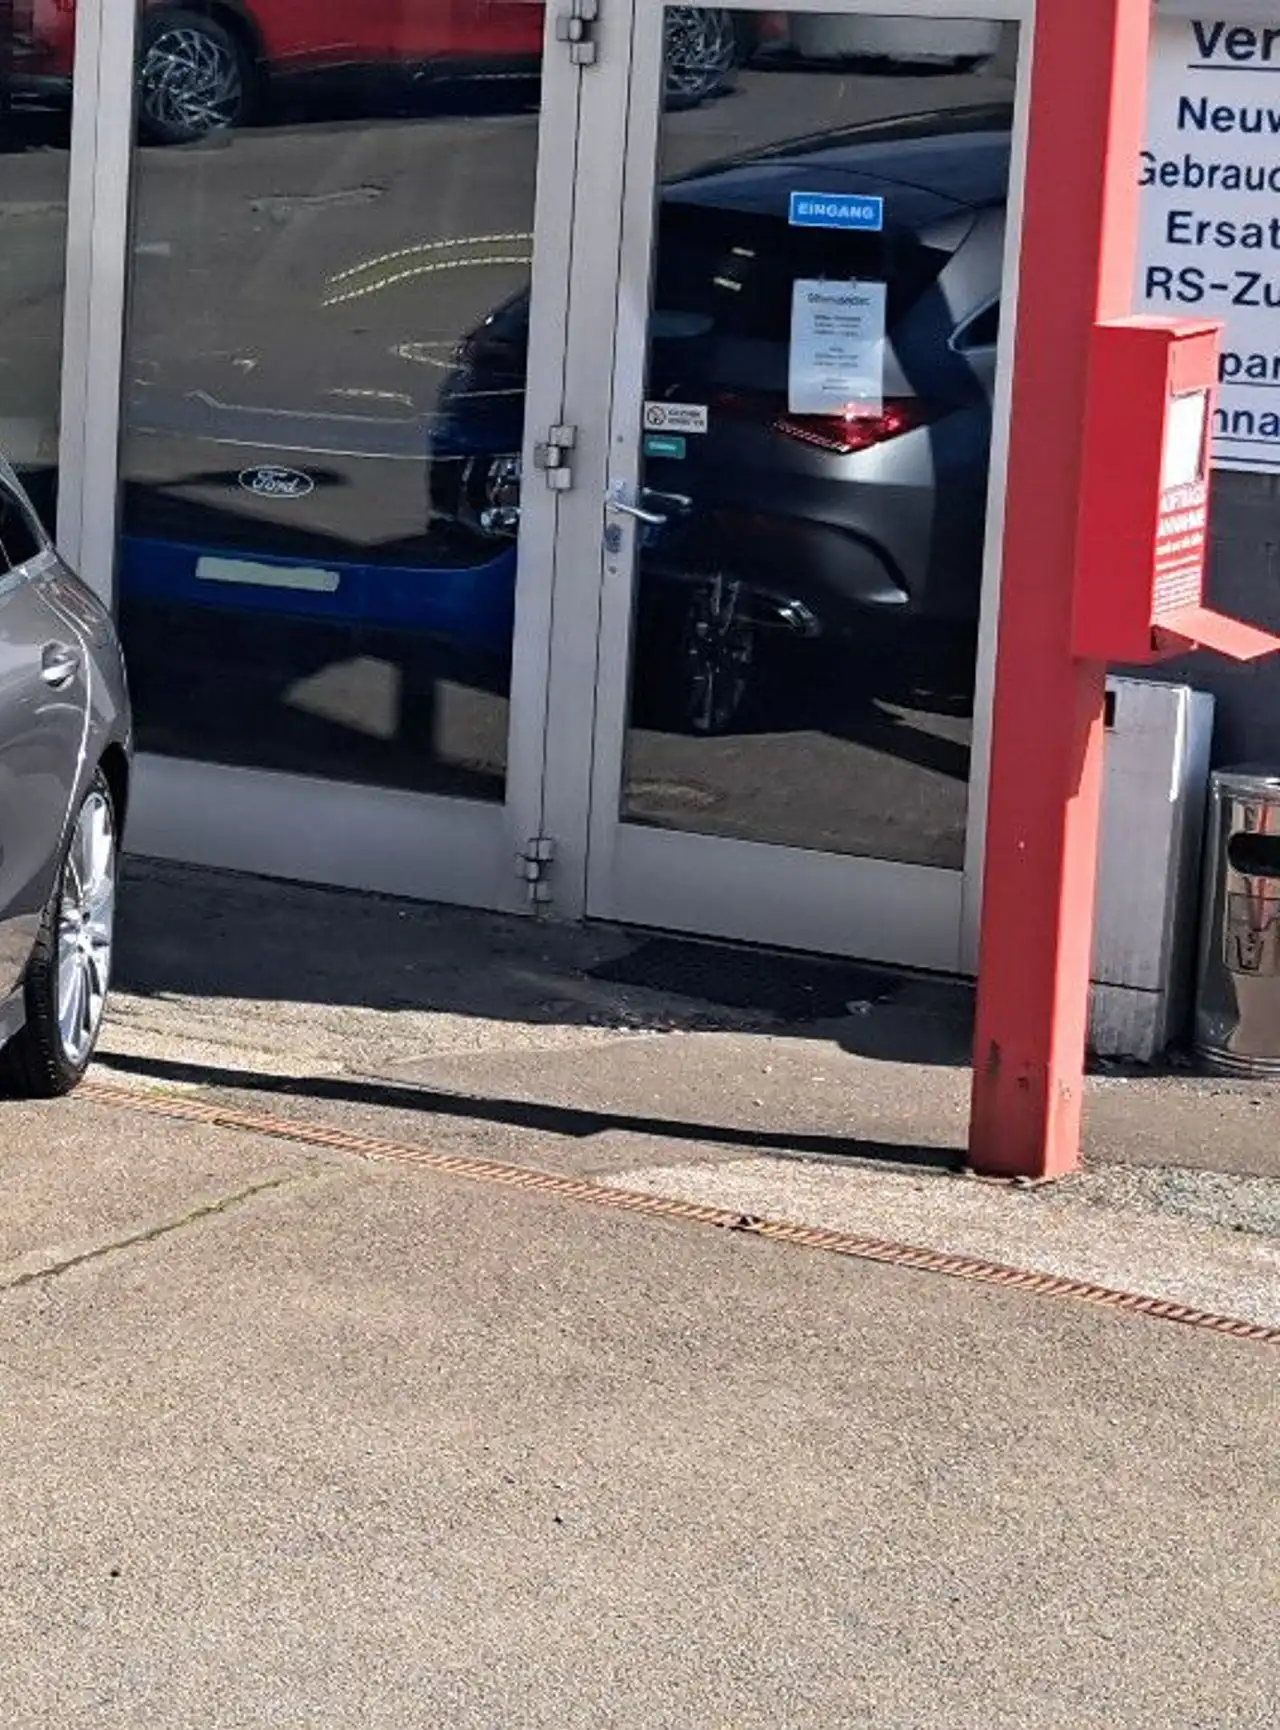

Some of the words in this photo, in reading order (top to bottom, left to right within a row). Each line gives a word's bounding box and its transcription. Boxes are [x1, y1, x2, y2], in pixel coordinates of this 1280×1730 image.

[1192, 19, 1280, 61] Ver
[797, 201, 874, 220] EINGANG
[252, 470, 300, 493] Ford
